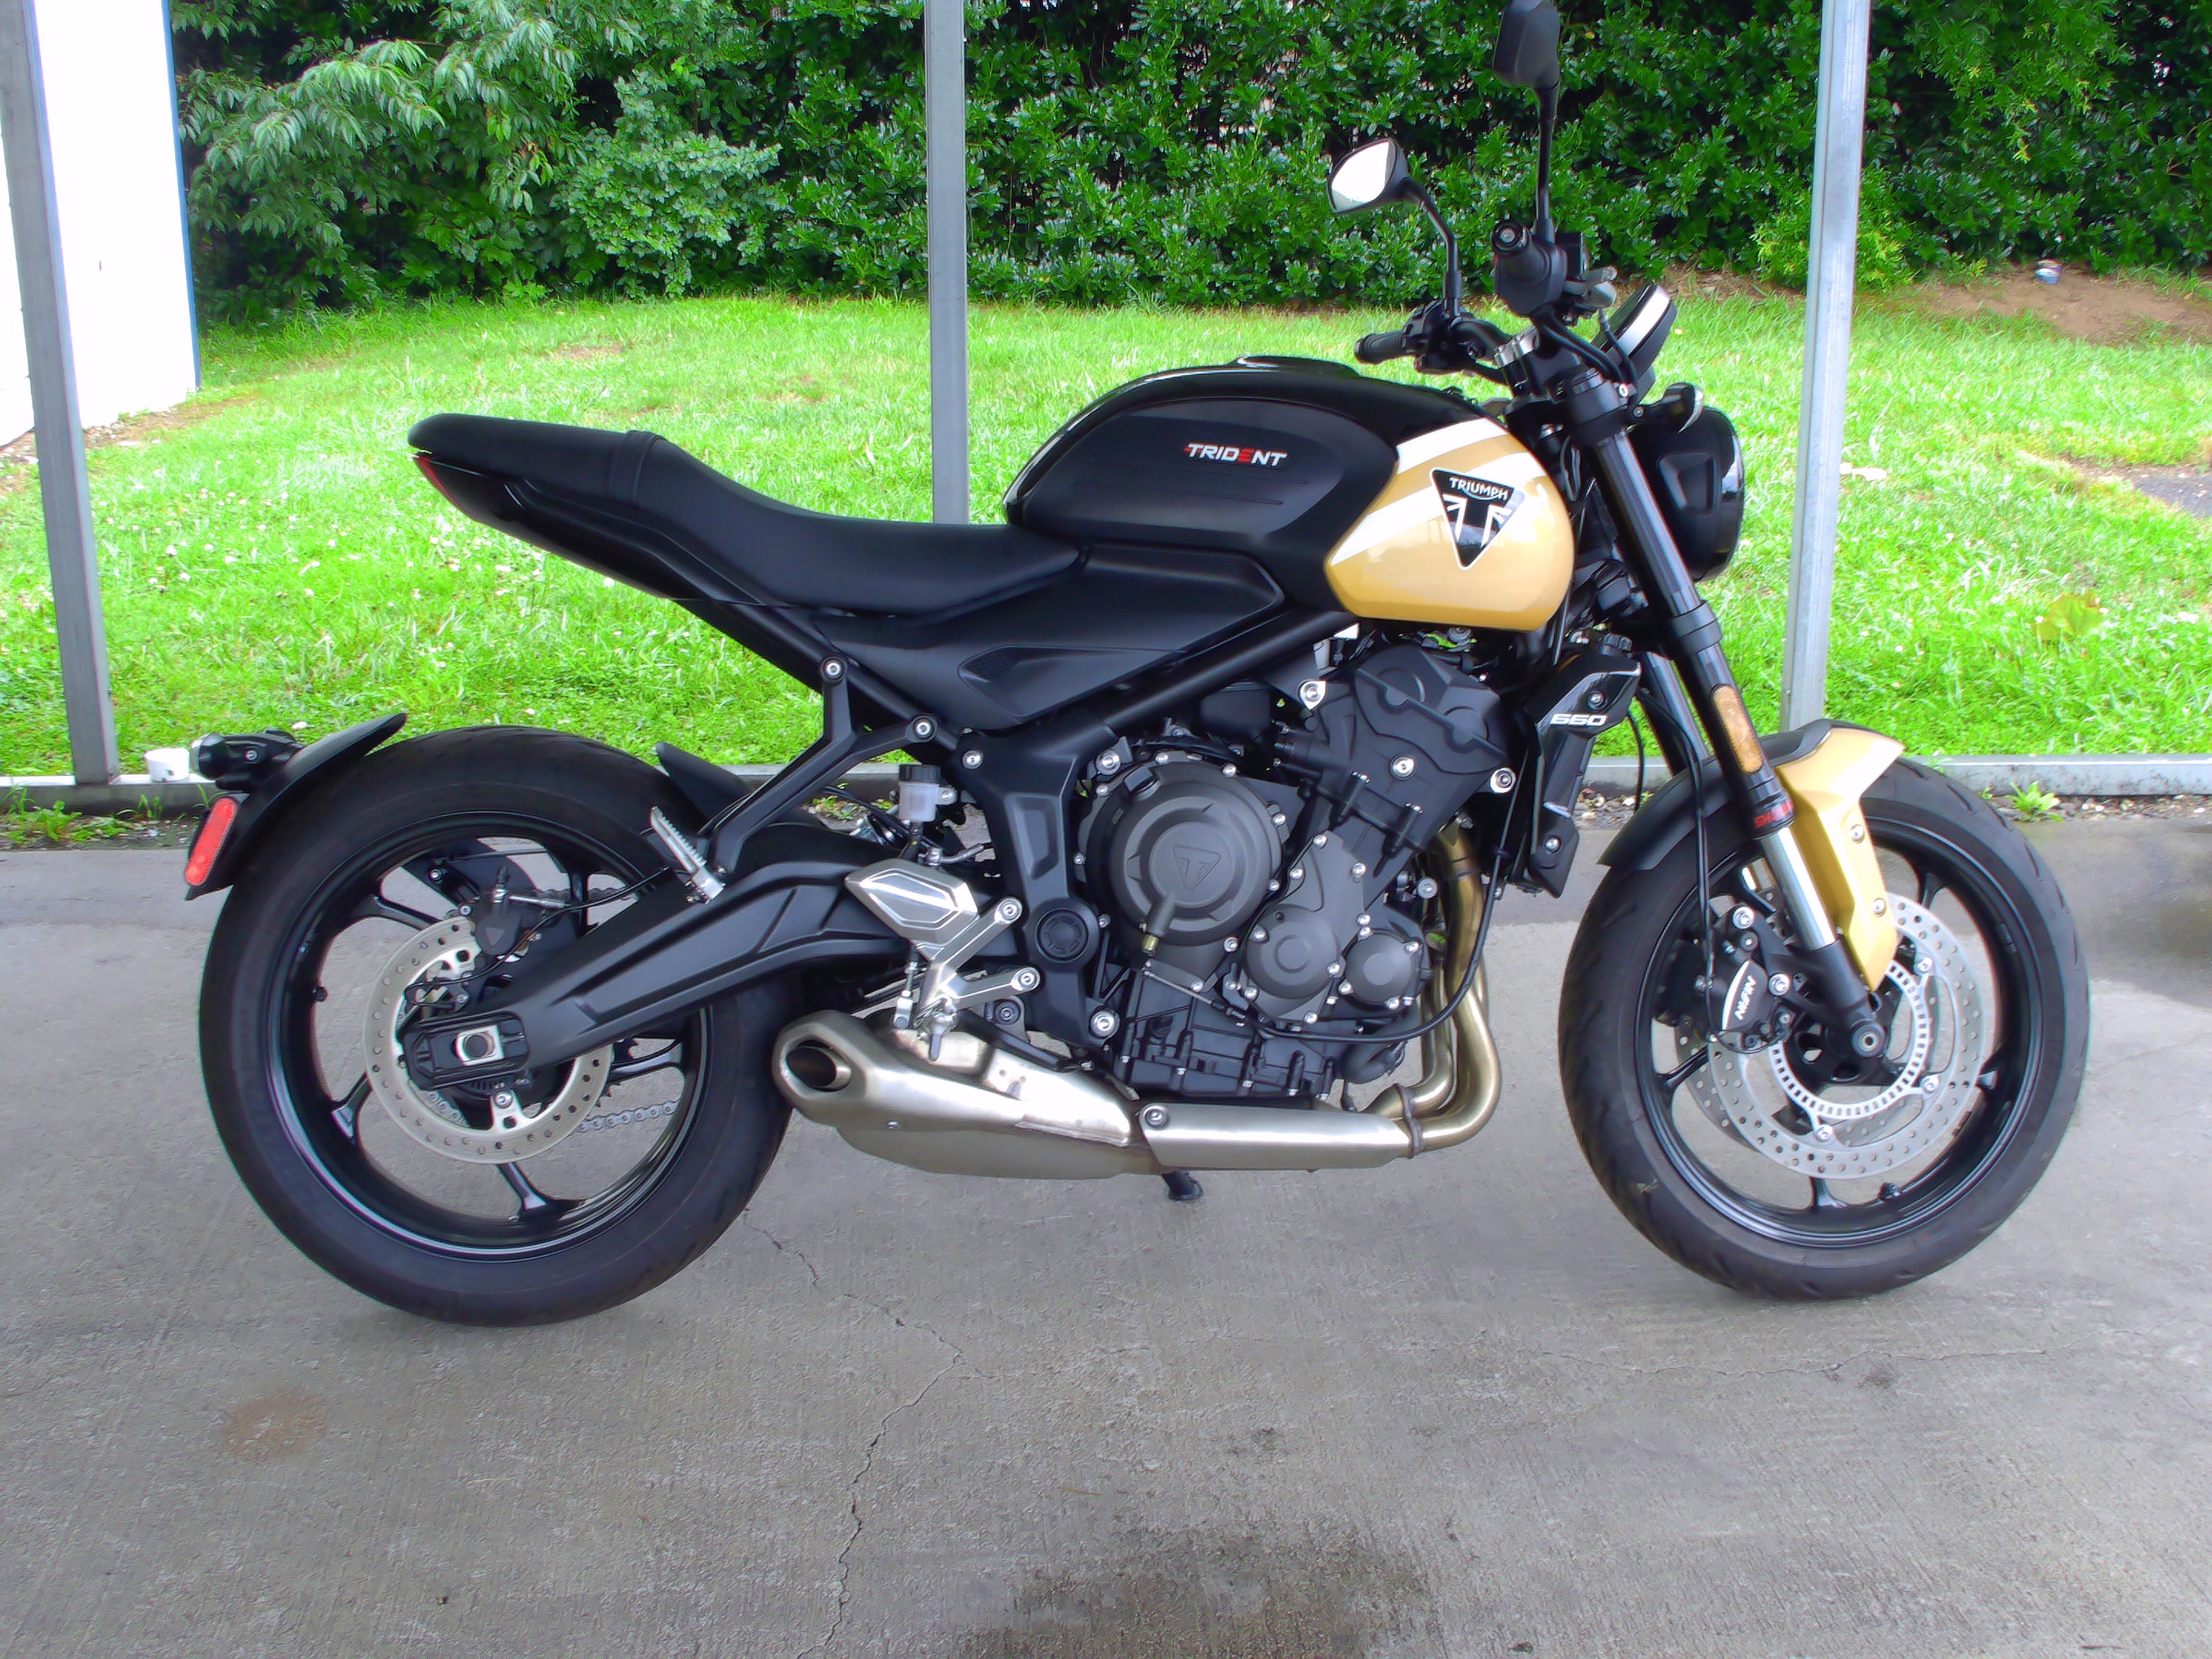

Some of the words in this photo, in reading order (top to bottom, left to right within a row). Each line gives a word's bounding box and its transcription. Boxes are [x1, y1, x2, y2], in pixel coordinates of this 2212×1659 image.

[1184, 442, 1287, 467] TRIDENT
[1449, 477, 1508, 501] TRIUMPH
[1550, 714, 1606, 726] 660
